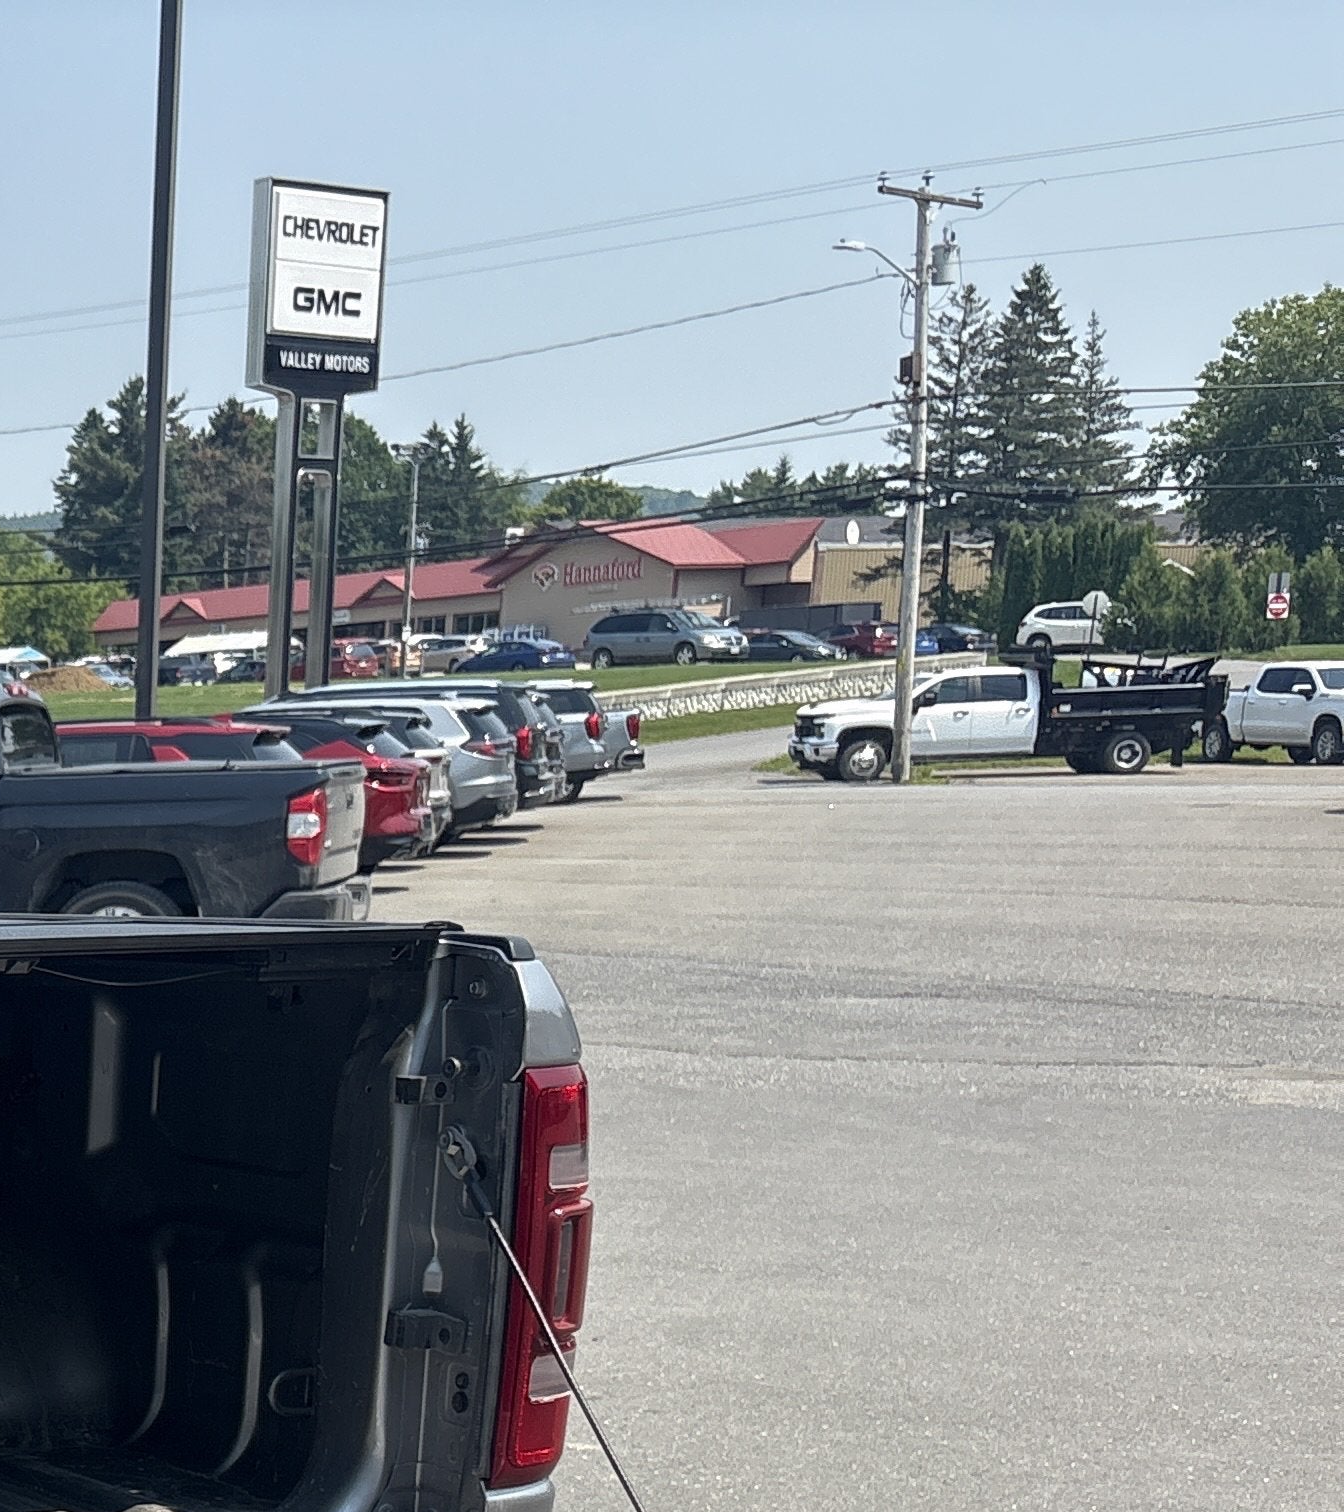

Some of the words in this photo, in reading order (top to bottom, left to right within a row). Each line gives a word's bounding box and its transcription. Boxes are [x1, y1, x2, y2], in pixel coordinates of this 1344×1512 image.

[282, 215, 380, 249] CHEVROLET
[292, 286, 362, 318] GMC
[279, 349, 323, 371] VALLEY
[323, 353, 370, 374] MOTORS
[563, 556, 642, 587] Hannaford
